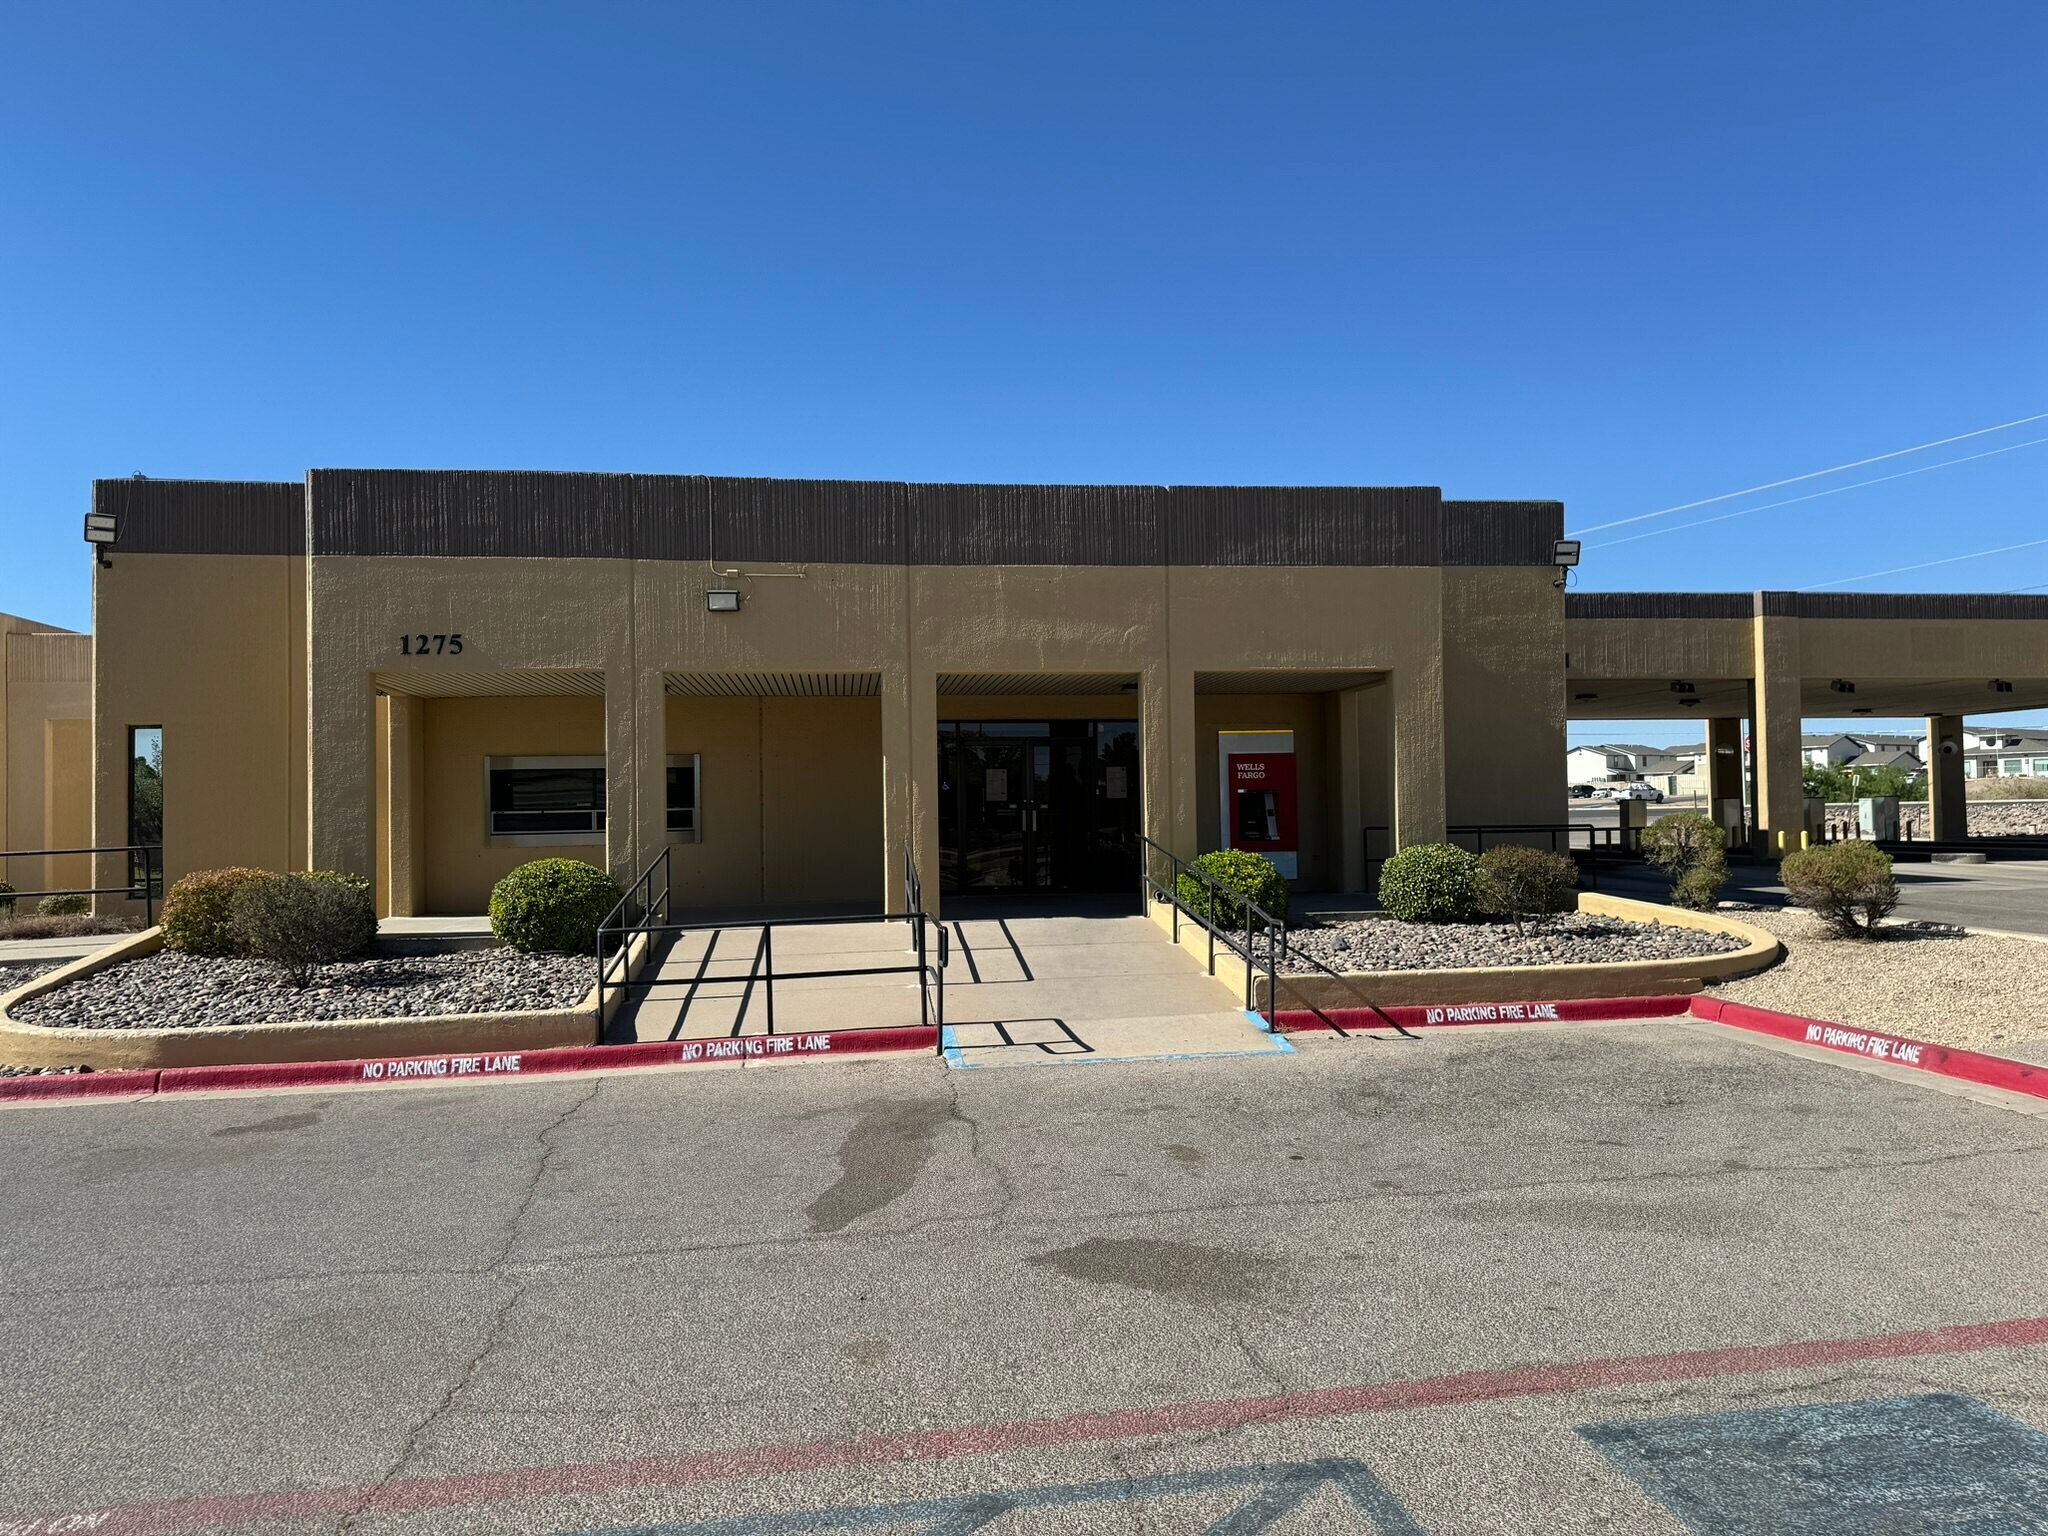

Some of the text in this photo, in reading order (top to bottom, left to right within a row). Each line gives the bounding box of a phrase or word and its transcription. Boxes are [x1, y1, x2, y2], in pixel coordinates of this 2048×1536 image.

[400, 633, 463, 655] 1275
[1236, 763, 1265, 771] WELLS
[1237, 771, 1266, 779] FARGO
[1426, 1003, 1558, 1025] NO PARKING FIRE LANE
[682, 1034, 831, 1061] NO PARKING FIRE LANE
[1805, 1023, 1923, 1064] NO PARKING FIRE LANE
[362, 1055, 521, 1079] NO PARKING FIRE LANE
